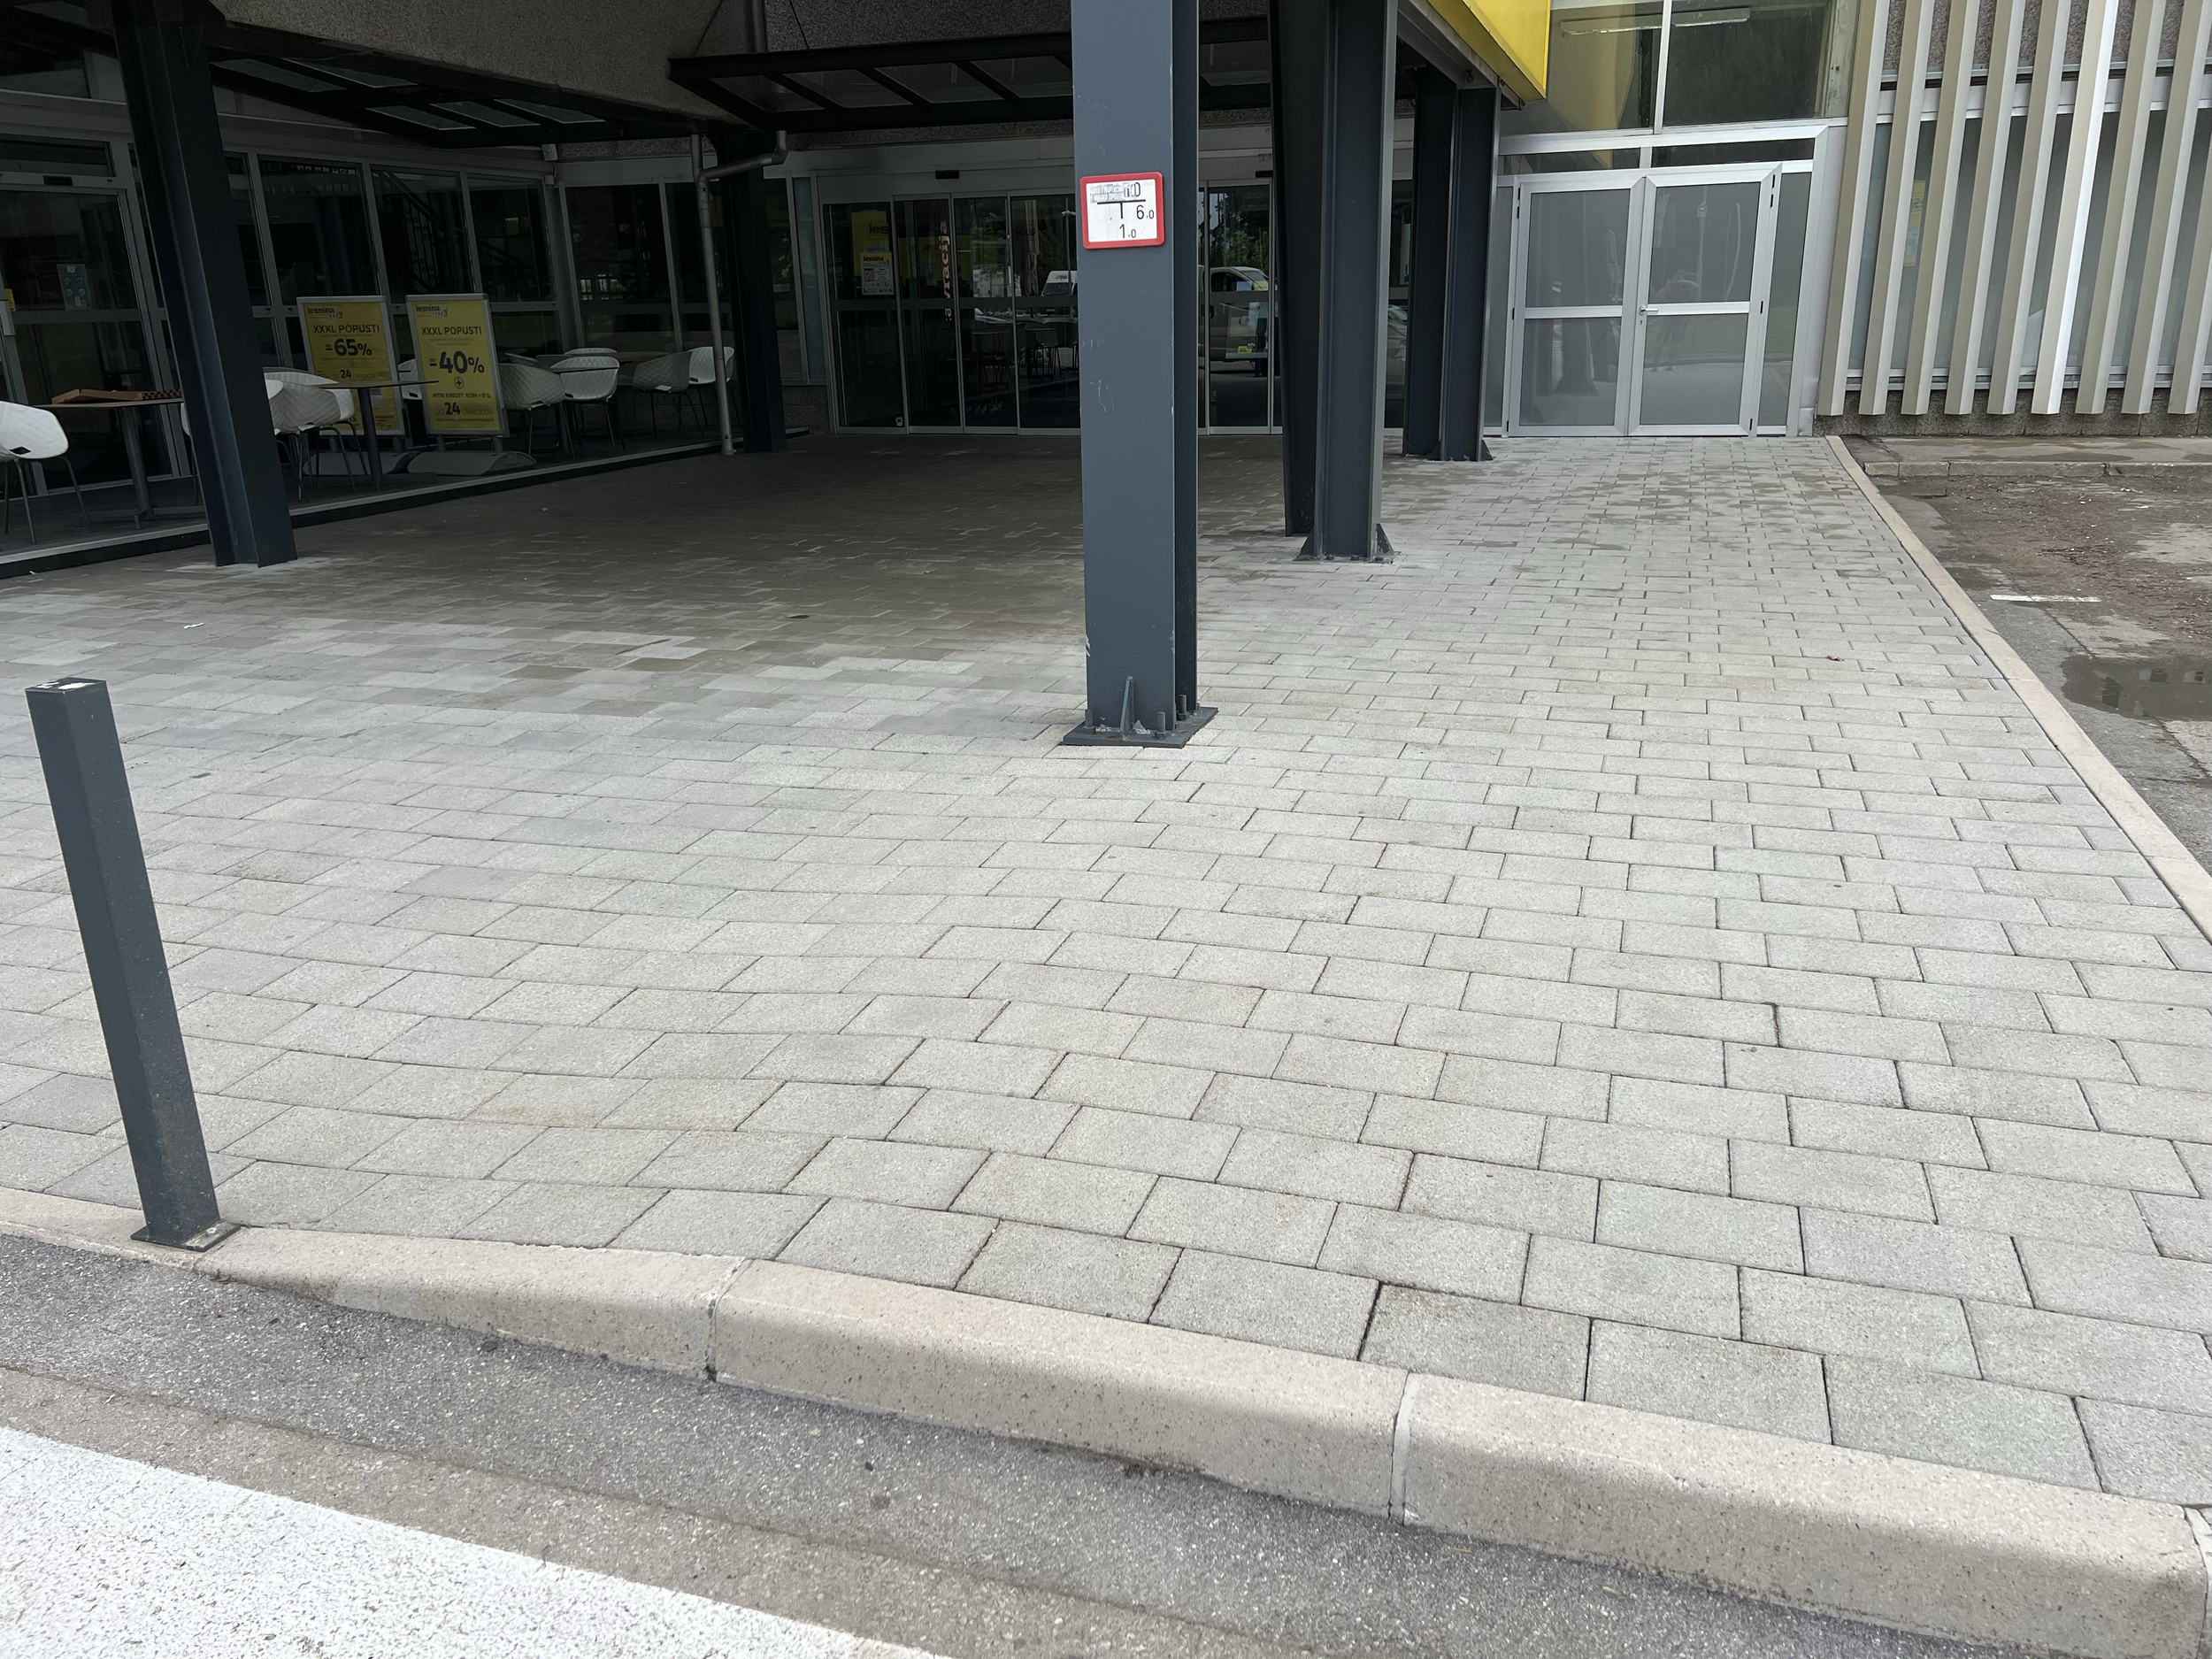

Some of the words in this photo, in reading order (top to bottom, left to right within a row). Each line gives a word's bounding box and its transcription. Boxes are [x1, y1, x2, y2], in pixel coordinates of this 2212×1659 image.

[313, 325, 336, 334] XXXL
[338, 324, 380, 333] POPUSTI
[421, 326, 443, 335] XXXL
[444, 326, 482, 335] POPUSTI
[340, 369, 351, 379] 24
[444, 402, 461, 415] 24
